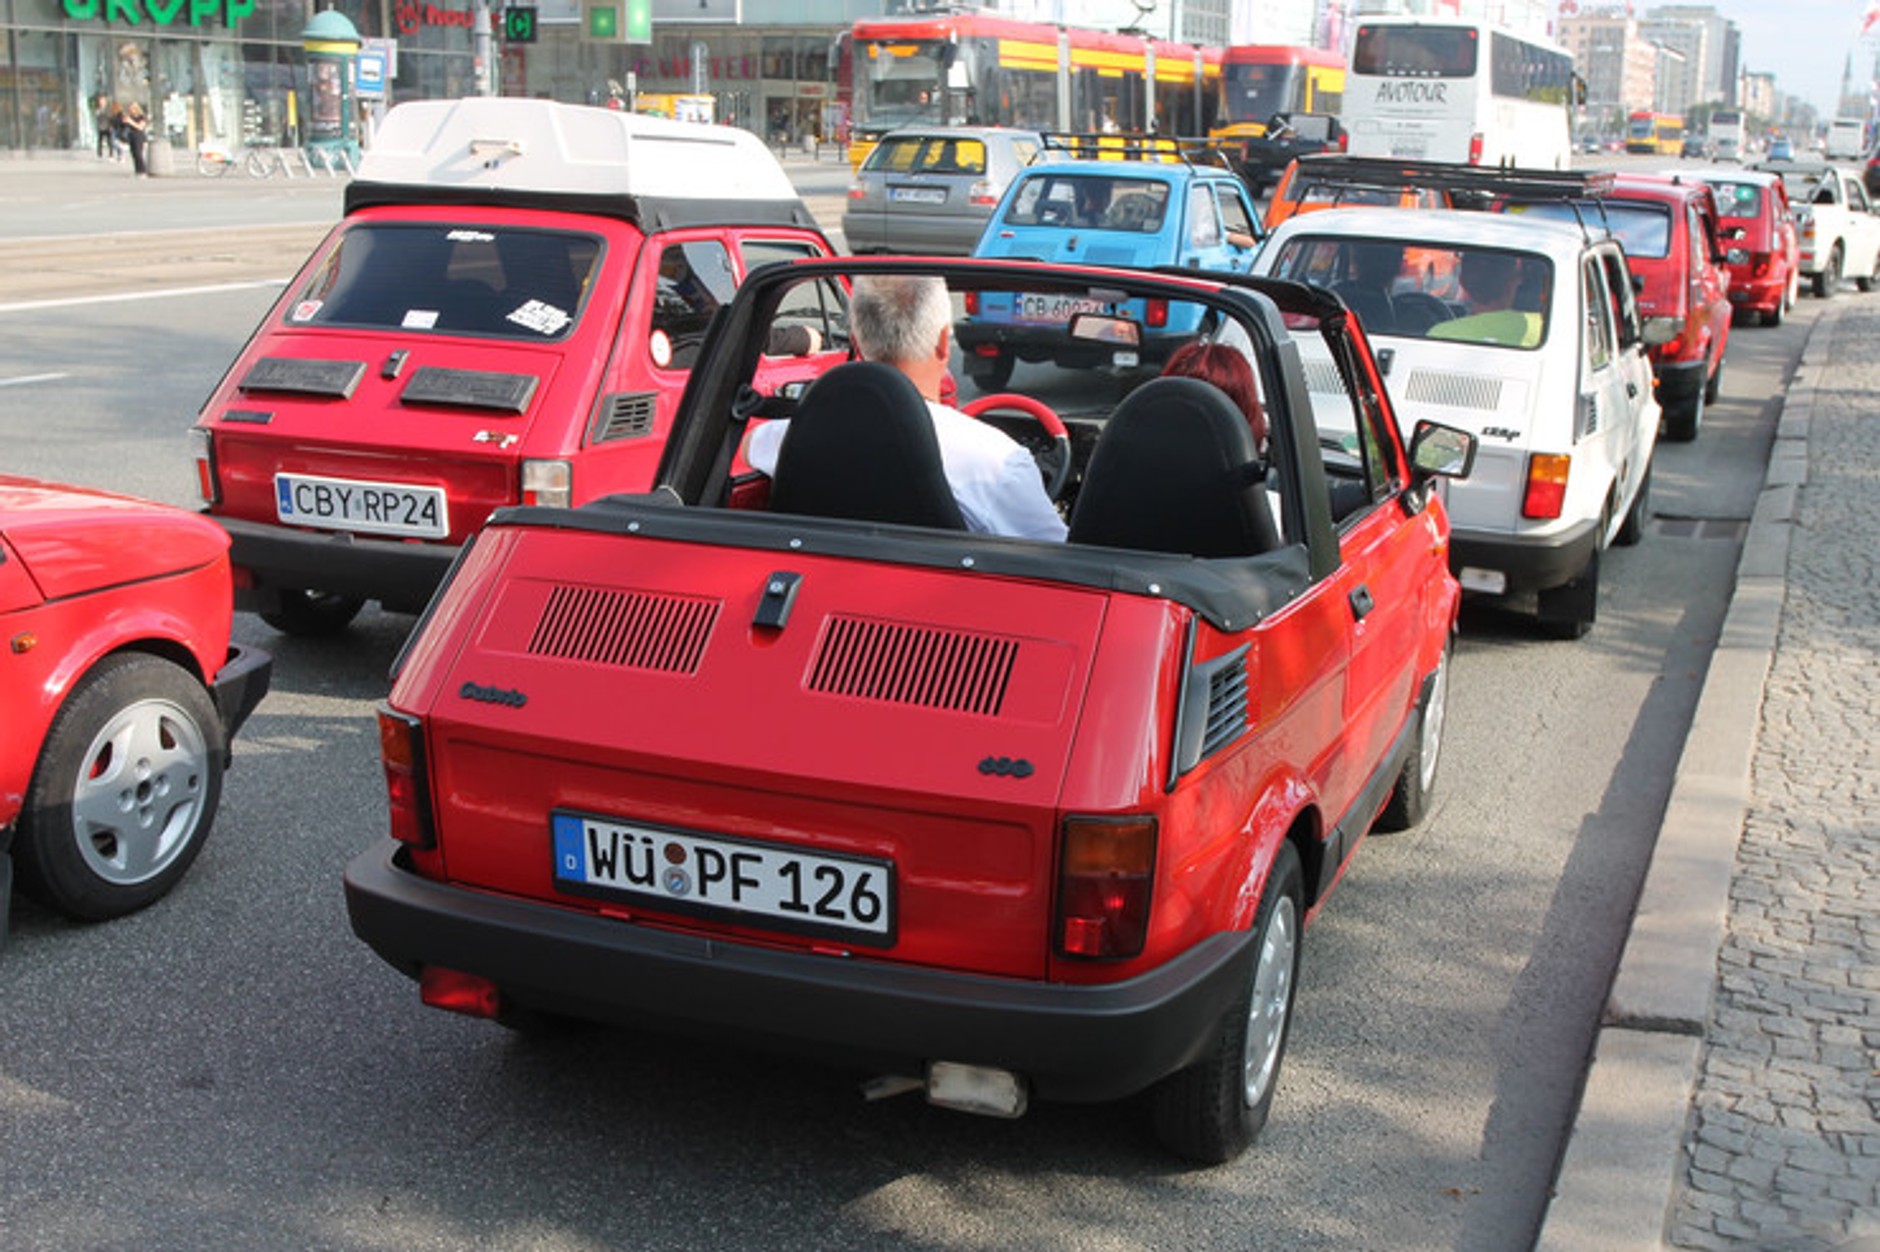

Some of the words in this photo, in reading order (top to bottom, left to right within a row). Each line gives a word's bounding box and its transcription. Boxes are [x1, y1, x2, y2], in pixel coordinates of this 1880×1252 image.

[294, 484, 352, 519] CBY
[363, 490, 438, 527] RP24
[694, 846, 763, 902] PF
[778, 861, 881, 924] 126
